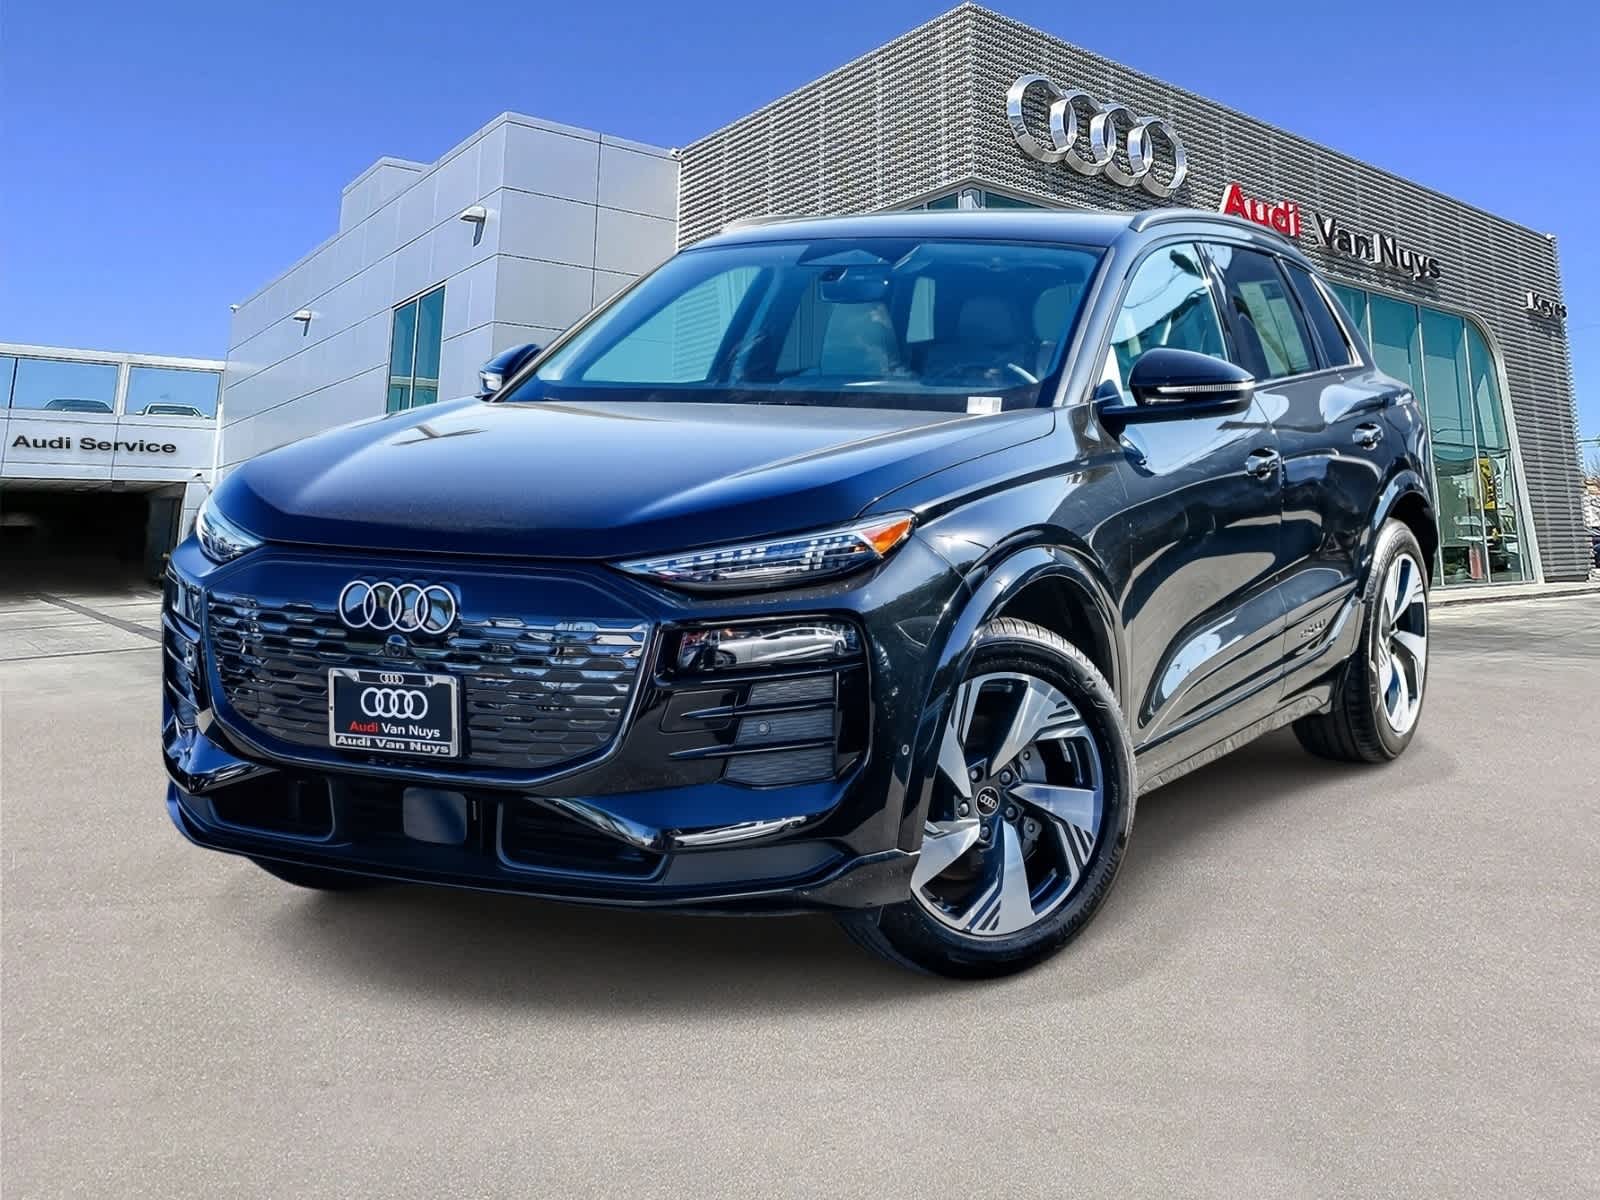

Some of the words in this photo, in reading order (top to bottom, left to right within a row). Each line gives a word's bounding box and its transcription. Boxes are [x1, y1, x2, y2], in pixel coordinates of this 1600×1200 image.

[1220, 181, 1302, 237] Audi
[1312, 211, 1370, 260] Van
[1374, 233, 1441, 281] Nuys
[12, 435, 71, 449] Audi
[79, 437, 177, 453] Service
[350, 721, 378, 732] Audi
[381, 723, 406, 735] Van
[408, 726, 441, 739] Nuys
[337, 736, 371, 747] Audi
[375, 739, 405, 750] Van
[409, 742, 449, 754] Nuys
